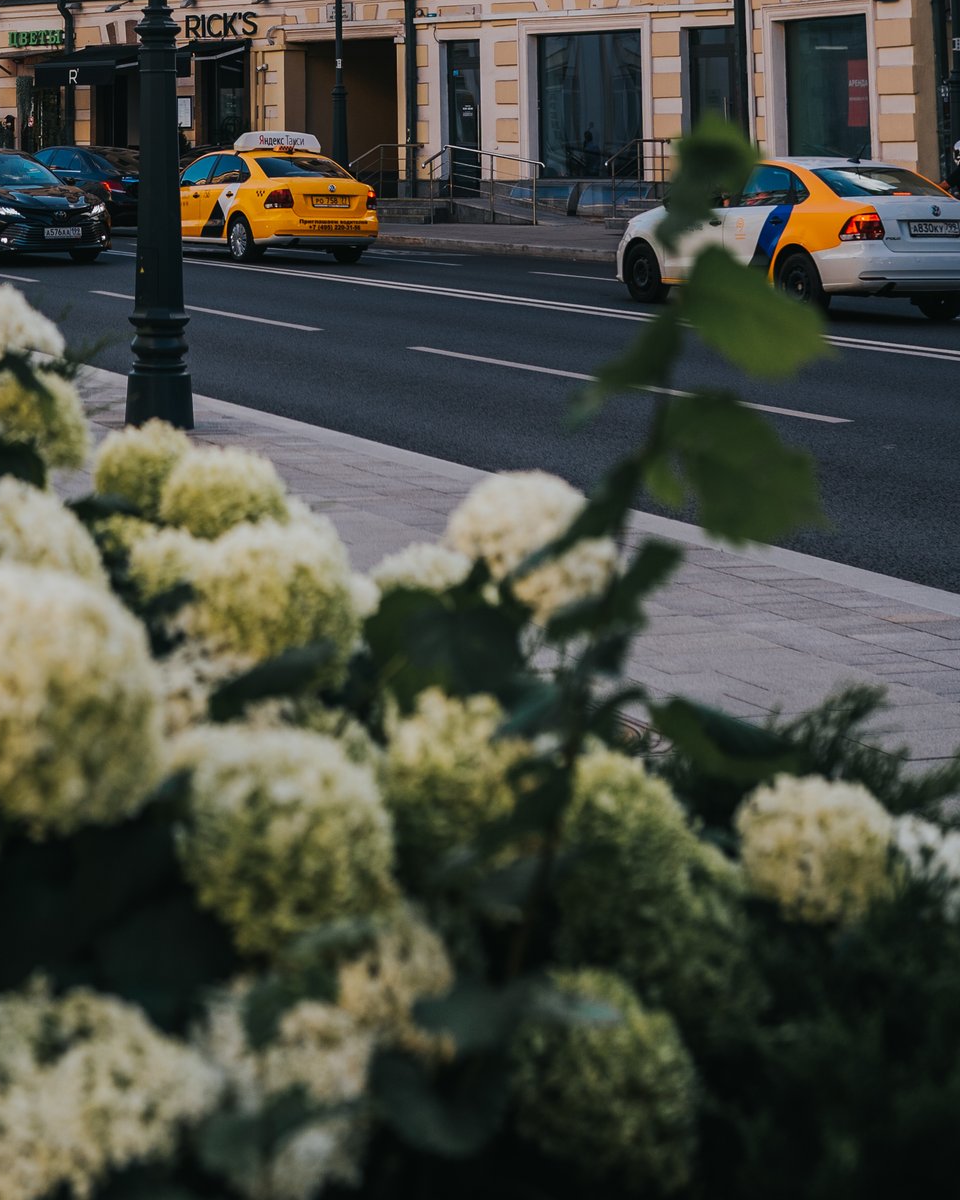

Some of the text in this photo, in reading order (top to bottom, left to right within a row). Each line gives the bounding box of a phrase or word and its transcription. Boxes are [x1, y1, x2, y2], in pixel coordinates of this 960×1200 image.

[185, 11, 258, 38] RICK'S
[8, 30, 62, 48] ЦВЕТЫ
[259, 135, 305, 146] Яндекс Такси
